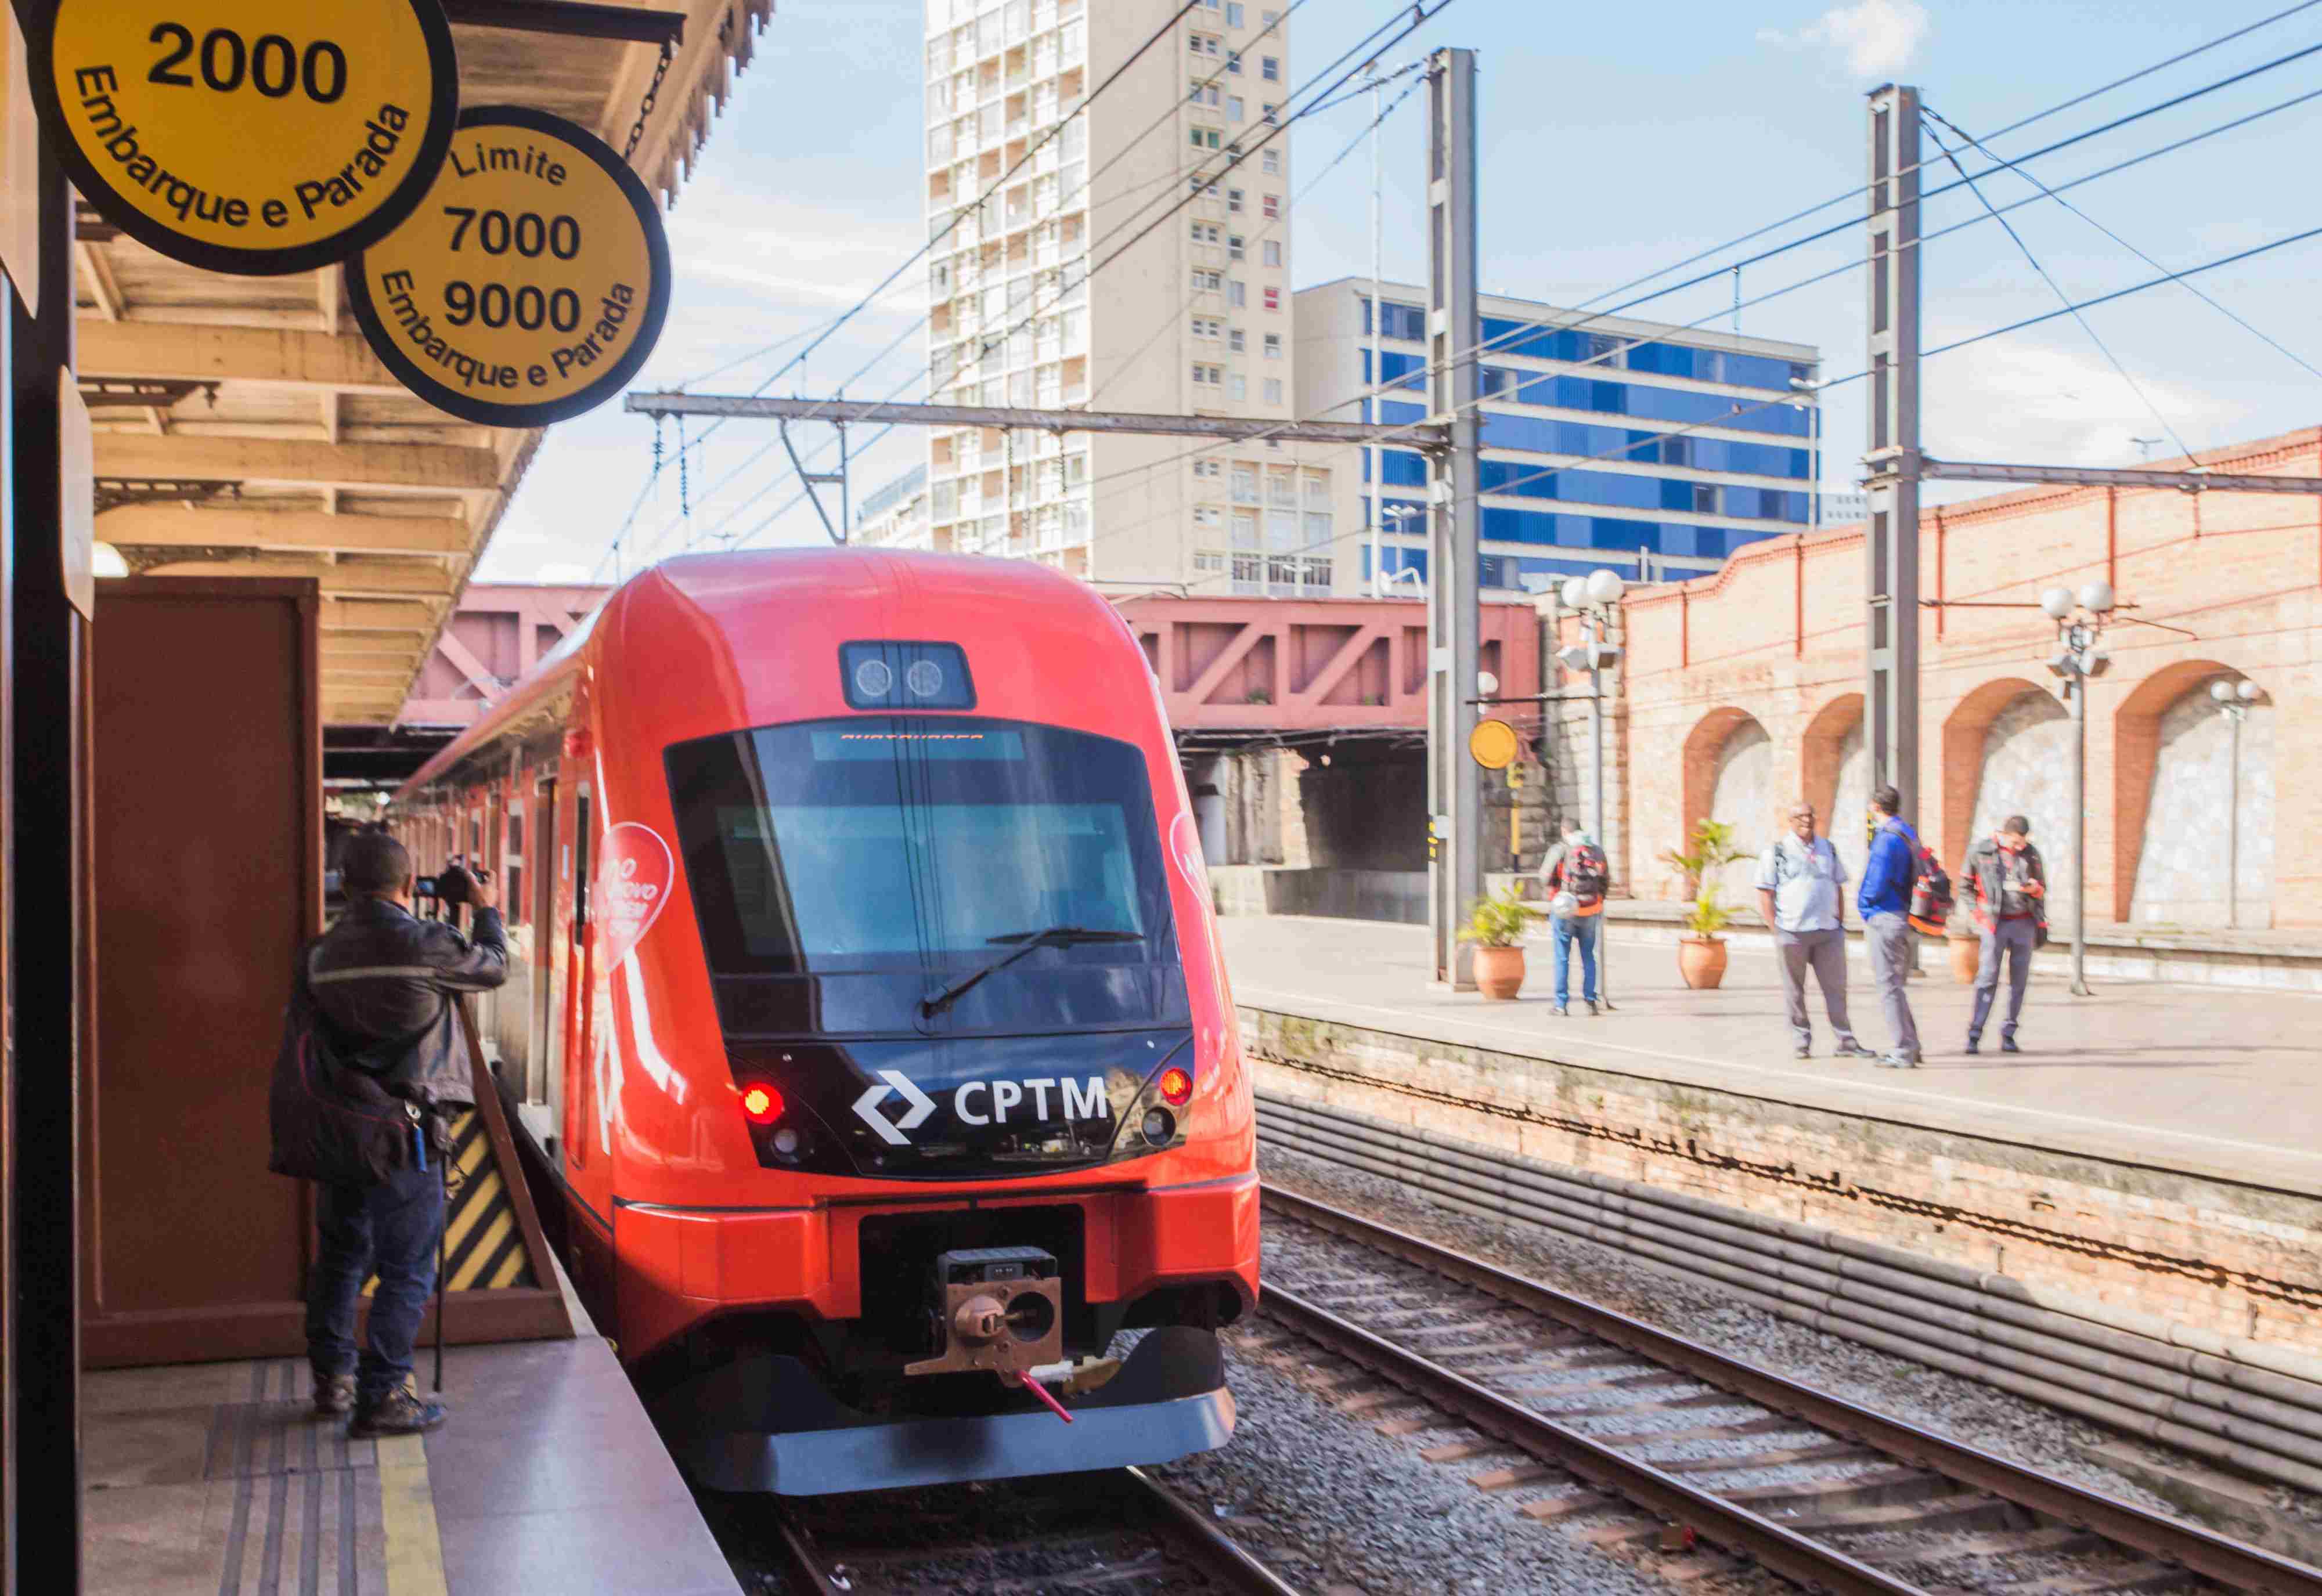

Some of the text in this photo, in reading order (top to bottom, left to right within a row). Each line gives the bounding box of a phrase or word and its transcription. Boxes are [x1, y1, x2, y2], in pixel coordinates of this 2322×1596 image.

[146, 21, 348, 105] 2000
[74, 64, 410, 229] Embarque e Parada
[450, 143, 567, 186] Limite
[443, 205, 581, 261] 7000
[381, 269, 634, 389] Embarque e Parada
[443, 280, 581, 333] 9000
[954, 1076, 1108, 1125] CPTM
